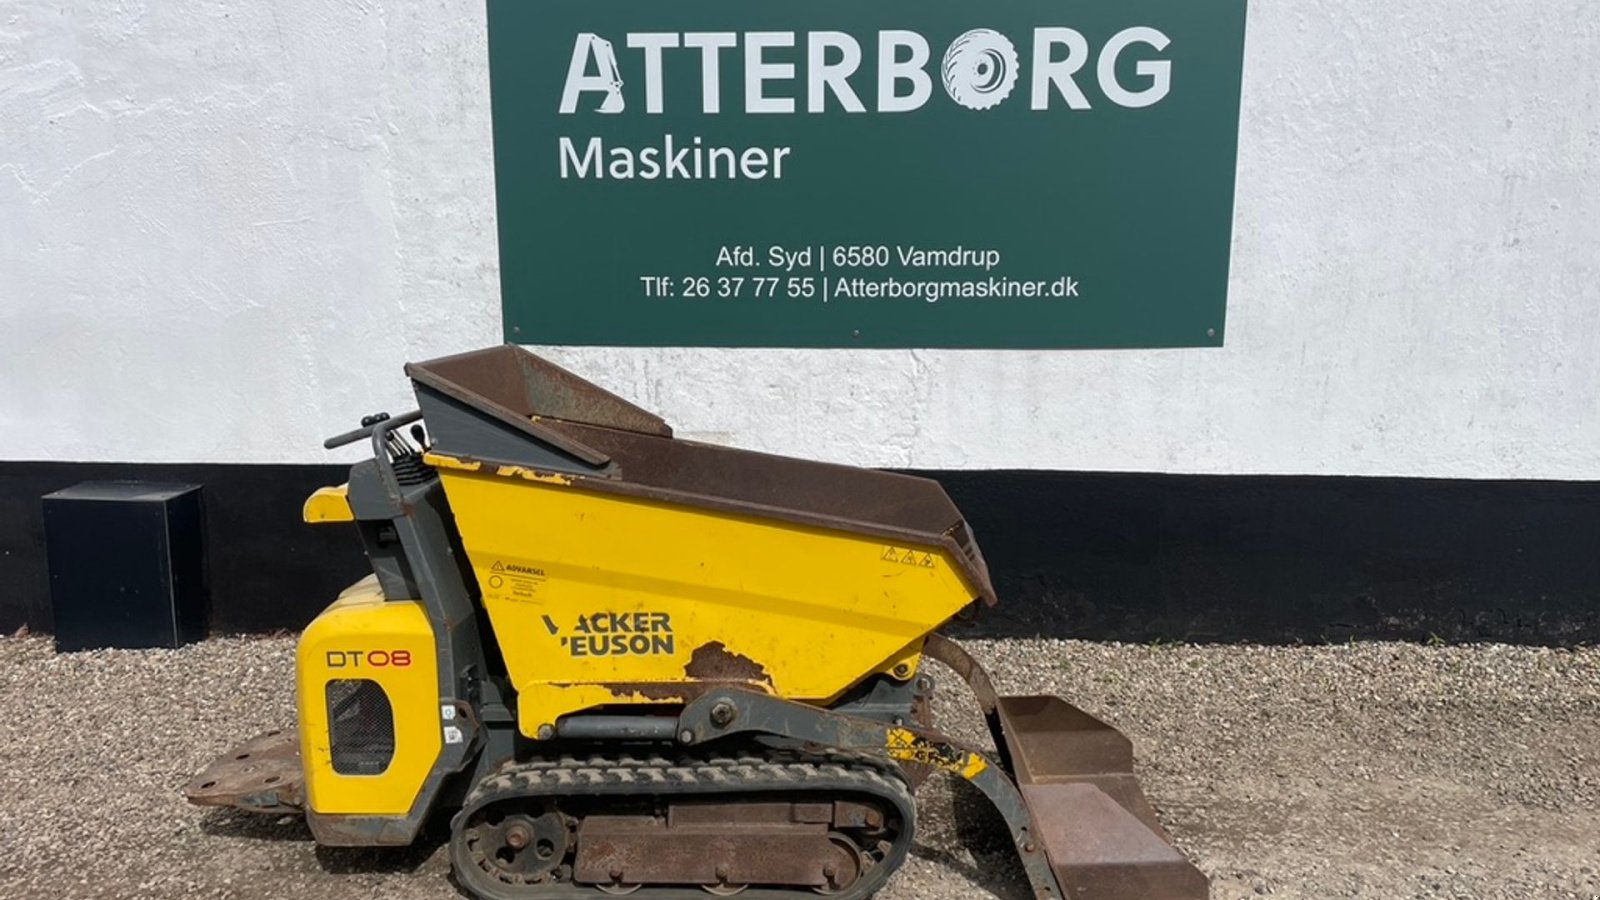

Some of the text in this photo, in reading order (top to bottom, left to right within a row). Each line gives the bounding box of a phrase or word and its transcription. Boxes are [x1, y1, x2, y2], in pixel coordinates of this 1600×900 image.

[558, 26, 1172, 114] ATTERBORG
[559, 134, 791, 180] Maskiner
[715, 246, 760, 267] Afd.
[768, 245, 811, 272] Syd
[832, 246, 890, 267] 6580
[896, 245, 1000, 271] Vamdrup
[640, 276, 674, 298] Tlf:
[682, 276, 711, 298] 26
[717, 276, 745, 298] 37
[752, 277, 780, 298] 77
[787, 277, 815, 298] 55
[834, 276, 1079, 302] Atterborgmaskiner.dk
[560, 634, 674, 657] EUSON
